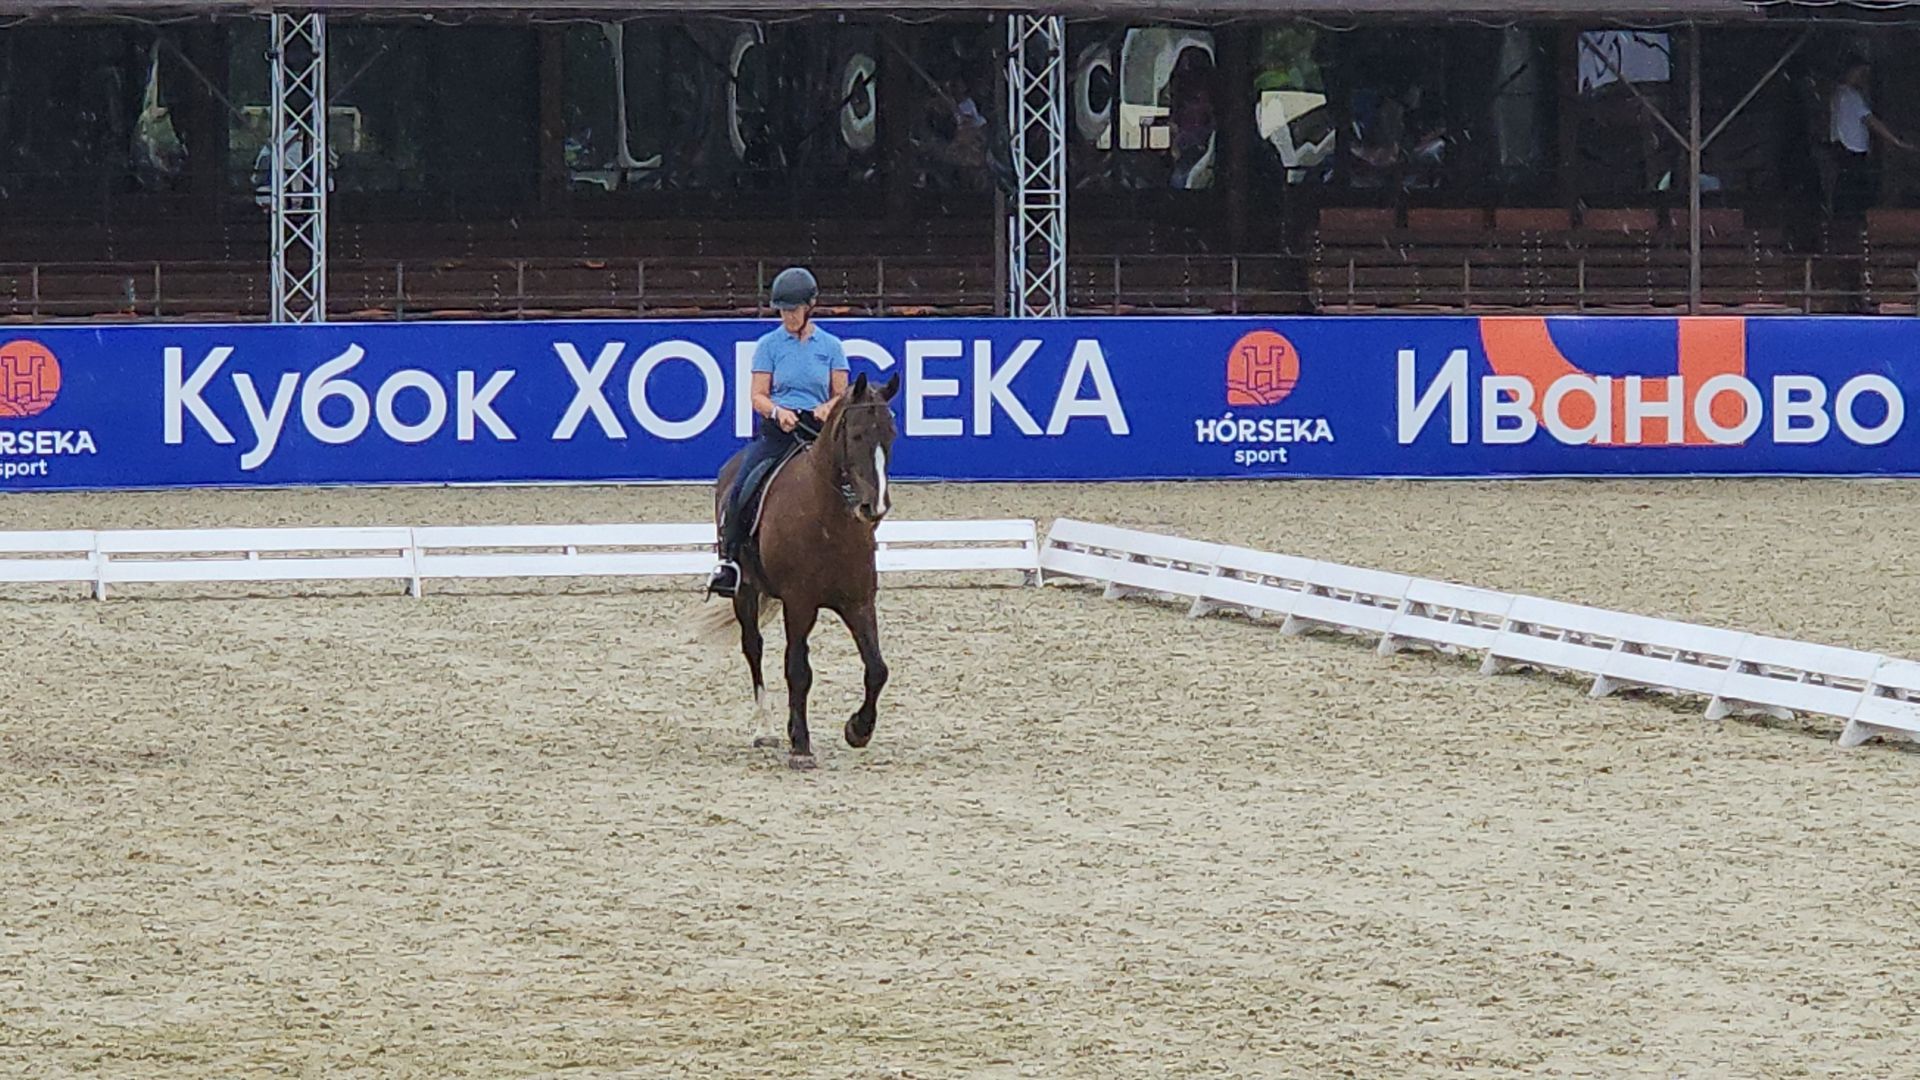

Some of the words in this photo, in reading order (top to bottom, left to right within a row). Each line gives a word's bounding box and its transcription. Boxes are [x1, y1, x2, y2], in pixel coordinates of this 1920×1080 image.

[163, 343, 517, 471] Кубок
[552, 339, 1131, 441] ХОЕКА
[1195, 412, 1335, 443] HÓRSEKA
[1397, 349, 1905, 446] Иваново
[1234, 447, 1288, 467] sport
